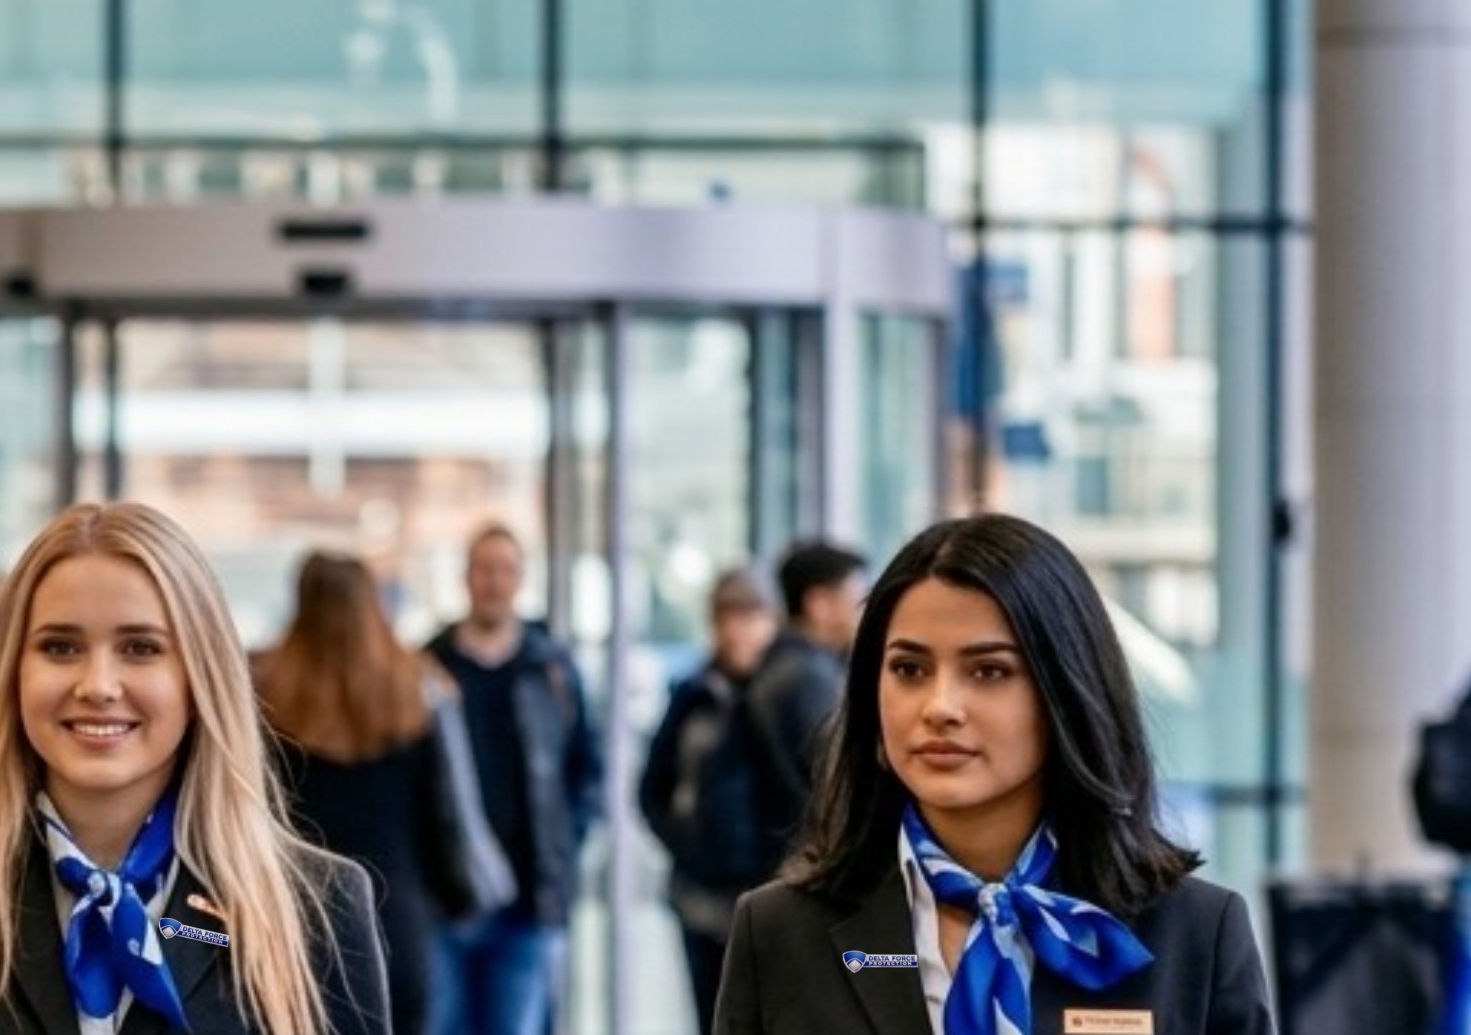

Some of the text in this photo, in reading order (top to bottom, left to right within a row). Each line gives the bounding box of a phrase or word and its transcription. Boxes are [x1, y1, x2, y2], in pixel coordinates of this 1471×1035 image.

[182, 926, 227, 940] DELTA FORCE
[182, 932, 222, 944] PROTECTION
